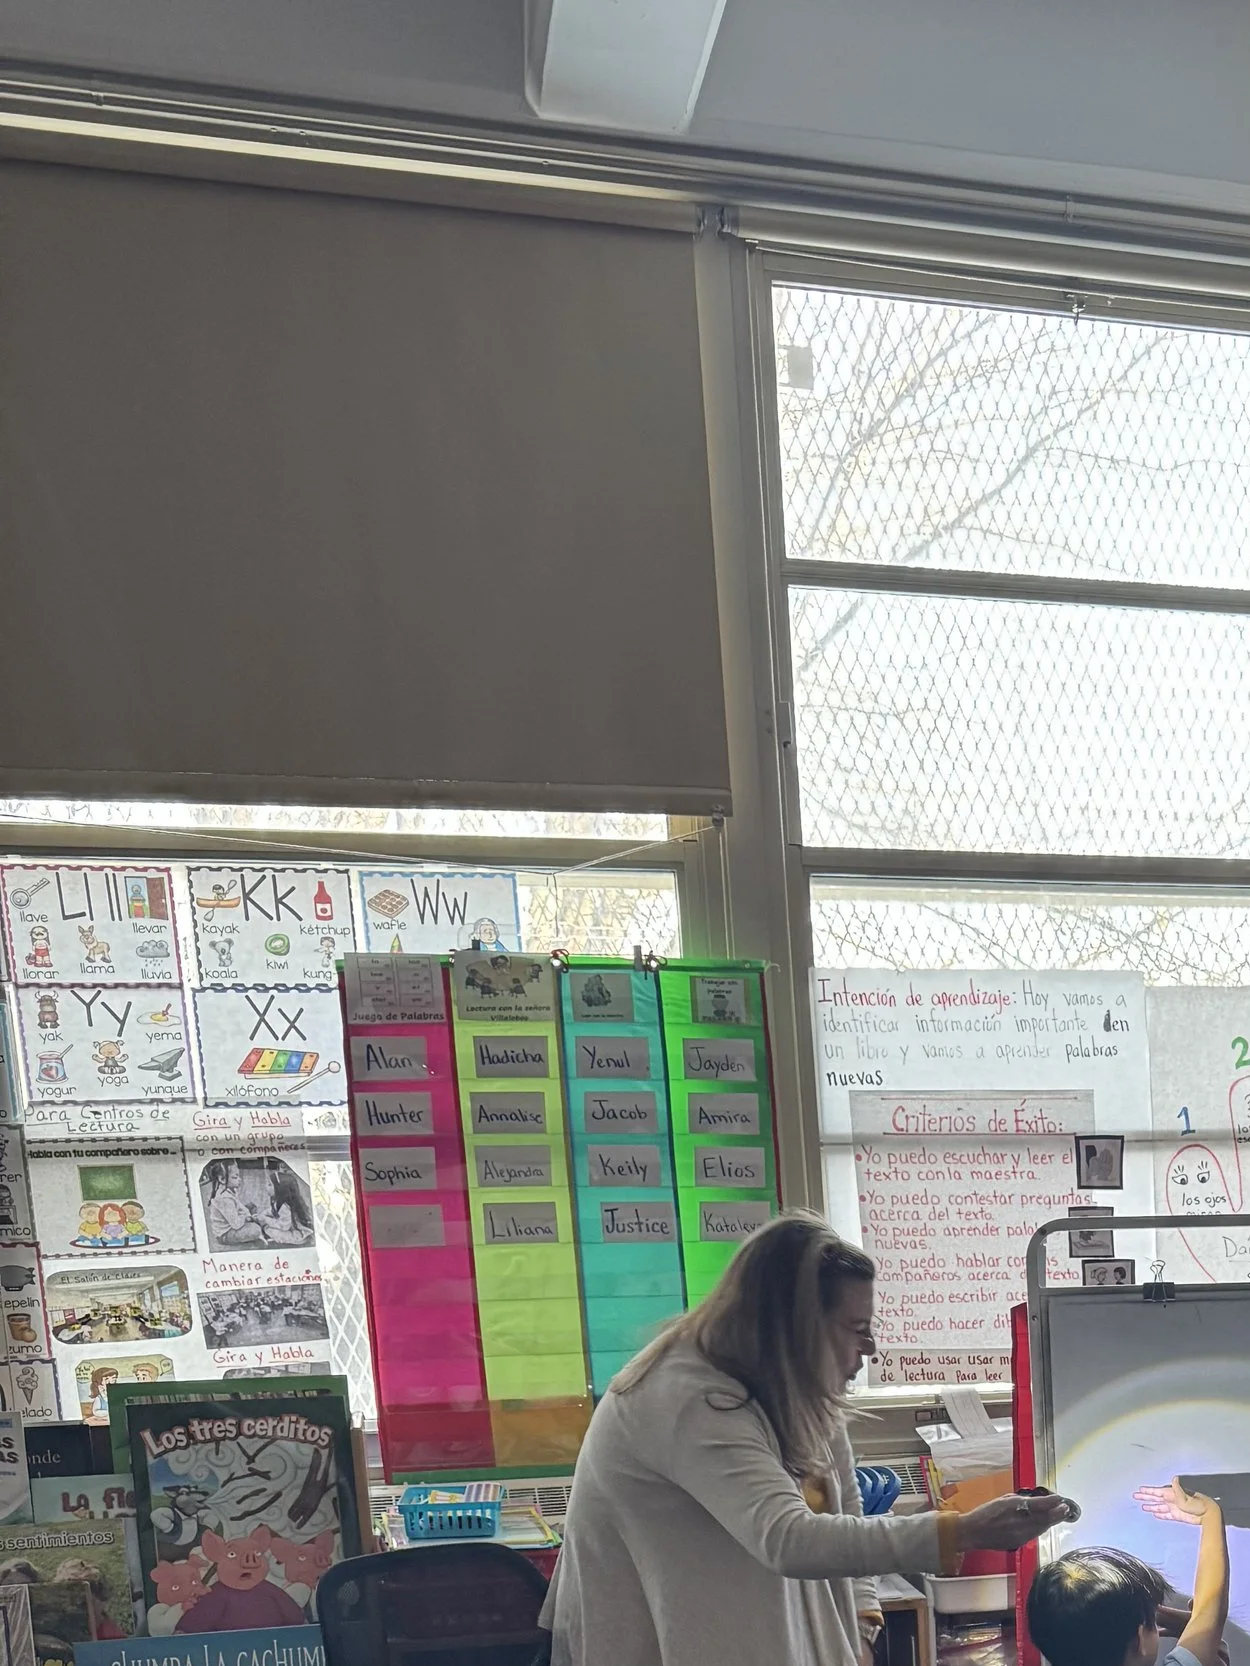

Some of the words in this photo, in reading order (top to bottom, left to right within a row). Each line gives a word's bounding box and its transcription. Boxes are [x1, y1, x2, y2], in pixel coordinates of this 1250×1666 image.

[240, 874, 303, 921] Kk
[411, 878, 467, 926] Ww
[20, 912, 48, 924] llave
[373, 919, 406, 931] wafle
[132, 923, 167, 934] llevar
[202, 923, 240, 936] kayak
[300, 924, 350, 936] kétchup
[80, 963, 115, 974] llama
[266, 959, 289, 970] kiwi
[22, 968, 59, 980] llorar
[141, 968, 172, 980] lluvia
[204, 968, 238, 980] koala
[818, 978, 896, 1007] Intención
[905, 982, 923, 1006] de
[931, 978, 1016, 1014] aprendizaje:
[1023, 980, 1049, 1009] Hoy
[1062, 991, 1103, 1007] vamos
[1116, 993, 1127, 1008] a
[70, 990, 132, 1037] Yy
[244, 995, 306, 1040] Xx
[353, 1012, 382, 1022] Juego
[386, 1011, 398, 1020] de
[401, 1011, 444, 1021] Palabras
[39, 1031, 62, 1042] yak
[145, 1031, 182, 1042] yema
[365, 1044, 412, 1070] Alan
[479, 1045, 544, 1066] Hadicha
[582, 1045, 630, 1069] Yenul
[1065, 1037, 1118, 1062] palabras
[689, 1046, 745, 1078] Jayden
[97, 1075, 129, 1086] yoga
[827, 1070, 883, 1086] nuevas
[37, 1085, 76, 1097] yogur
[141, 1084, 188, 1096] yunque
[226, 1085, 279, 1098] xilófono
[24, 1105, 70, 1123] Para
[150, 1106, 170, 1120] de
[366, 1101, 423, 1126] Hunter
[477, 1104, 543, 1125] Annalise
[592, 1100, 647, 1121] Jacob
[698, 1107, 750, 1124] Amira
[892, 1104, 976, 1133] Criterios
[988, 1109, 1008, 1132] de
[1014, 1098, 1063, 1133] Éxito:
[67, 1121, 140, 1133] Lectura
[193, 1111, 227, 1127] Gira
[234, 1117, 242, 1130] y
[250, 1111, 291, 1125] Habla
[1177, 1106, 1196, 1136] 1
[862, 1145, 883, 1165] Yo
[888, 1148, 938, 1167] puedo
[942, 1146, 1007, 1165] escuchar
[1011, 1153, 1020, 1168] y
[1027, 1146, 1054, 1165] leer
[1062, 1147, 1073, 1165] el
[365, 1161, 421, 1185] Sophia
[484, 1160, 544, 1181] Alejandra
[600, 1153, 647, 1181] Keily
[703, 1156, 755, 1179] Elios
[491, 1213, 553, 1239] Liliana
[604, 1208, 670, 1235] Justice
[202, 1258, 263, 1273] Manera
[274, 1257, 289, 1270] de
[205, 1275, 261, 1289] cambiar
[879, 1352, 893, 1366] Yo
[900, 1351, 931, 1369] puedo
[938, 1354, 961, 1365] usar
[967, 1353, 994, 1365] usar
[880, 1370, 895, 1382] de
[905, 1367, 945, 1382] lectura
[985, 1367, 1002, 1381] leer
[141, 1424, 188, 1458] Los
[189, 1416, 238, 1445] tres
[240, 1413, 333, 1448] cerditos
[8, 1531, 114, 1550] sentimientos
